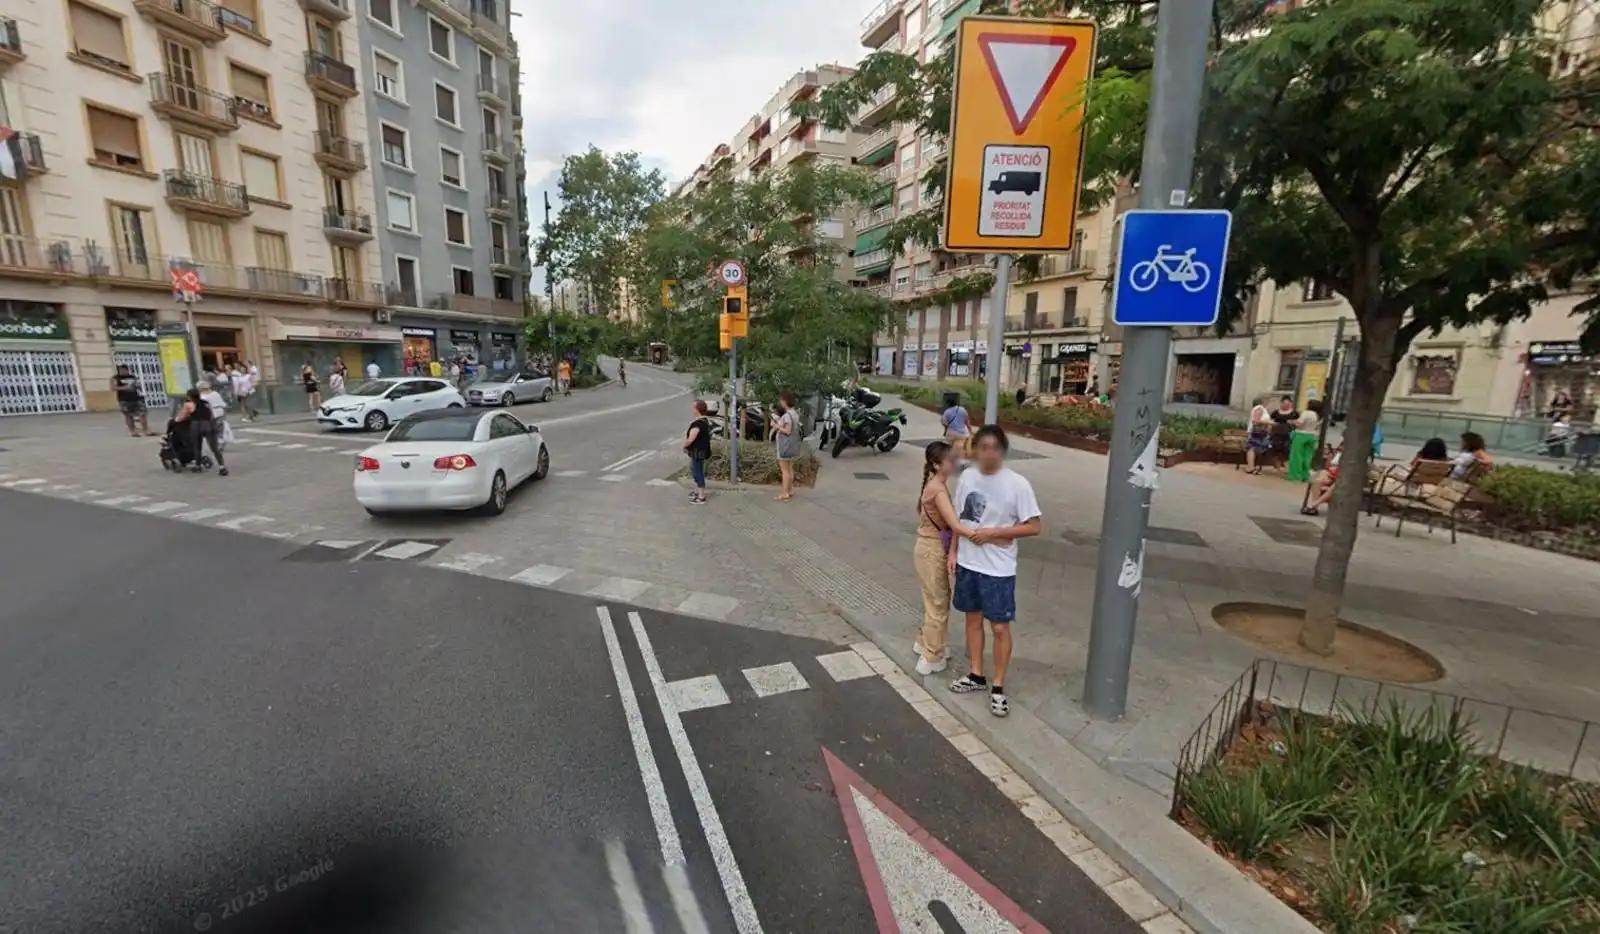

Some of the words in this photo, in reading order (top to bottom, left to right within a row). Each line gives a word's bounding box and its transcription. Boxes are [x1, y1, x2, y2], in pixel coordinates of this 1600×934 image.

[992, 153, 1041, 165] ATENCIÓ
[991, 211, 1031, 220] RECOLLIDA
[725, 269, 739, 278] 30
